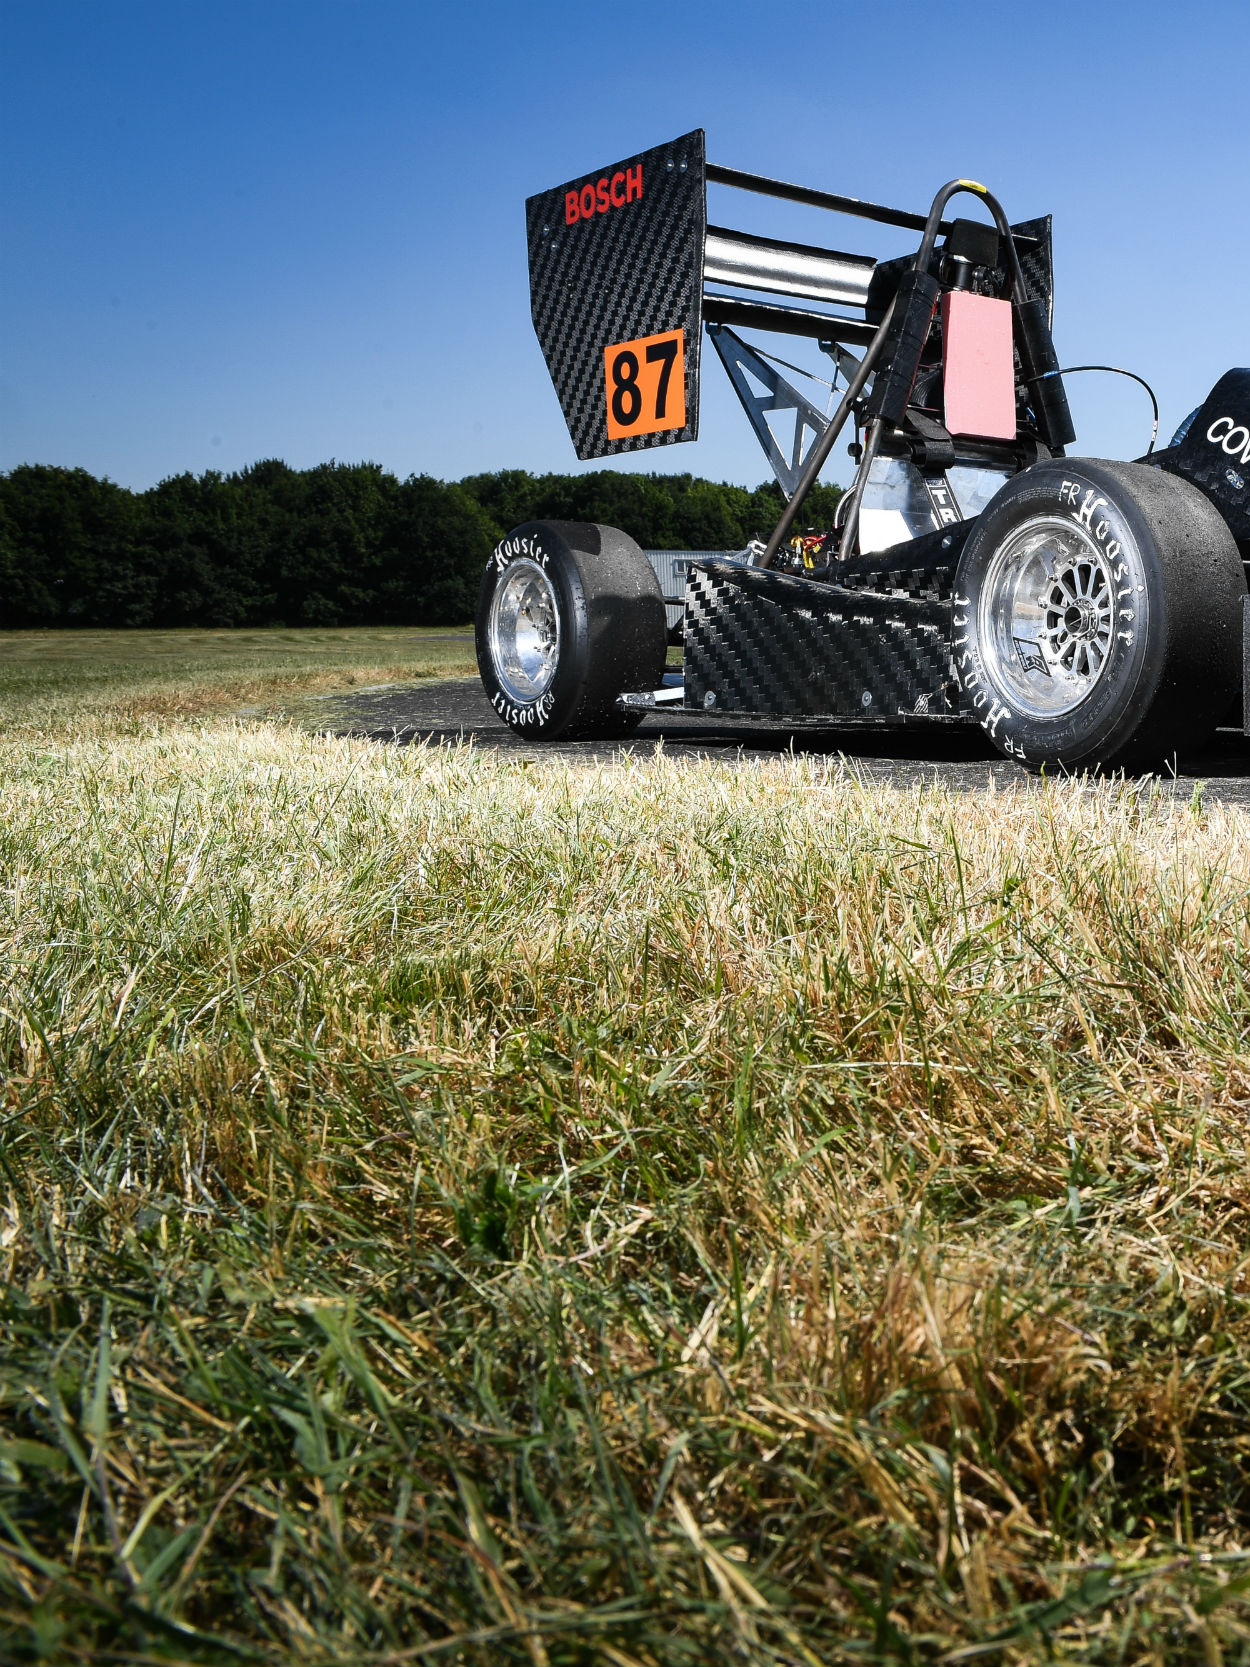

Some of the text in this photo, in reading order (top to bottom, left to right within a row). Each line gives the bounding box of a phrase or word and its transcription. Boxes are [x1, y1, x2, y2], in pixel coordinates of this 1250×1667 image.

[565, 164, 643, 225] BOSCH
[611, 338, 679, 427] 87
[494, 533, 550, 573] Hoosier
[1058, 480, 1081, 506] FR
[1071, 489, 1145, 647] Hoosier
[491, 691, 549, 727] Hoosier
